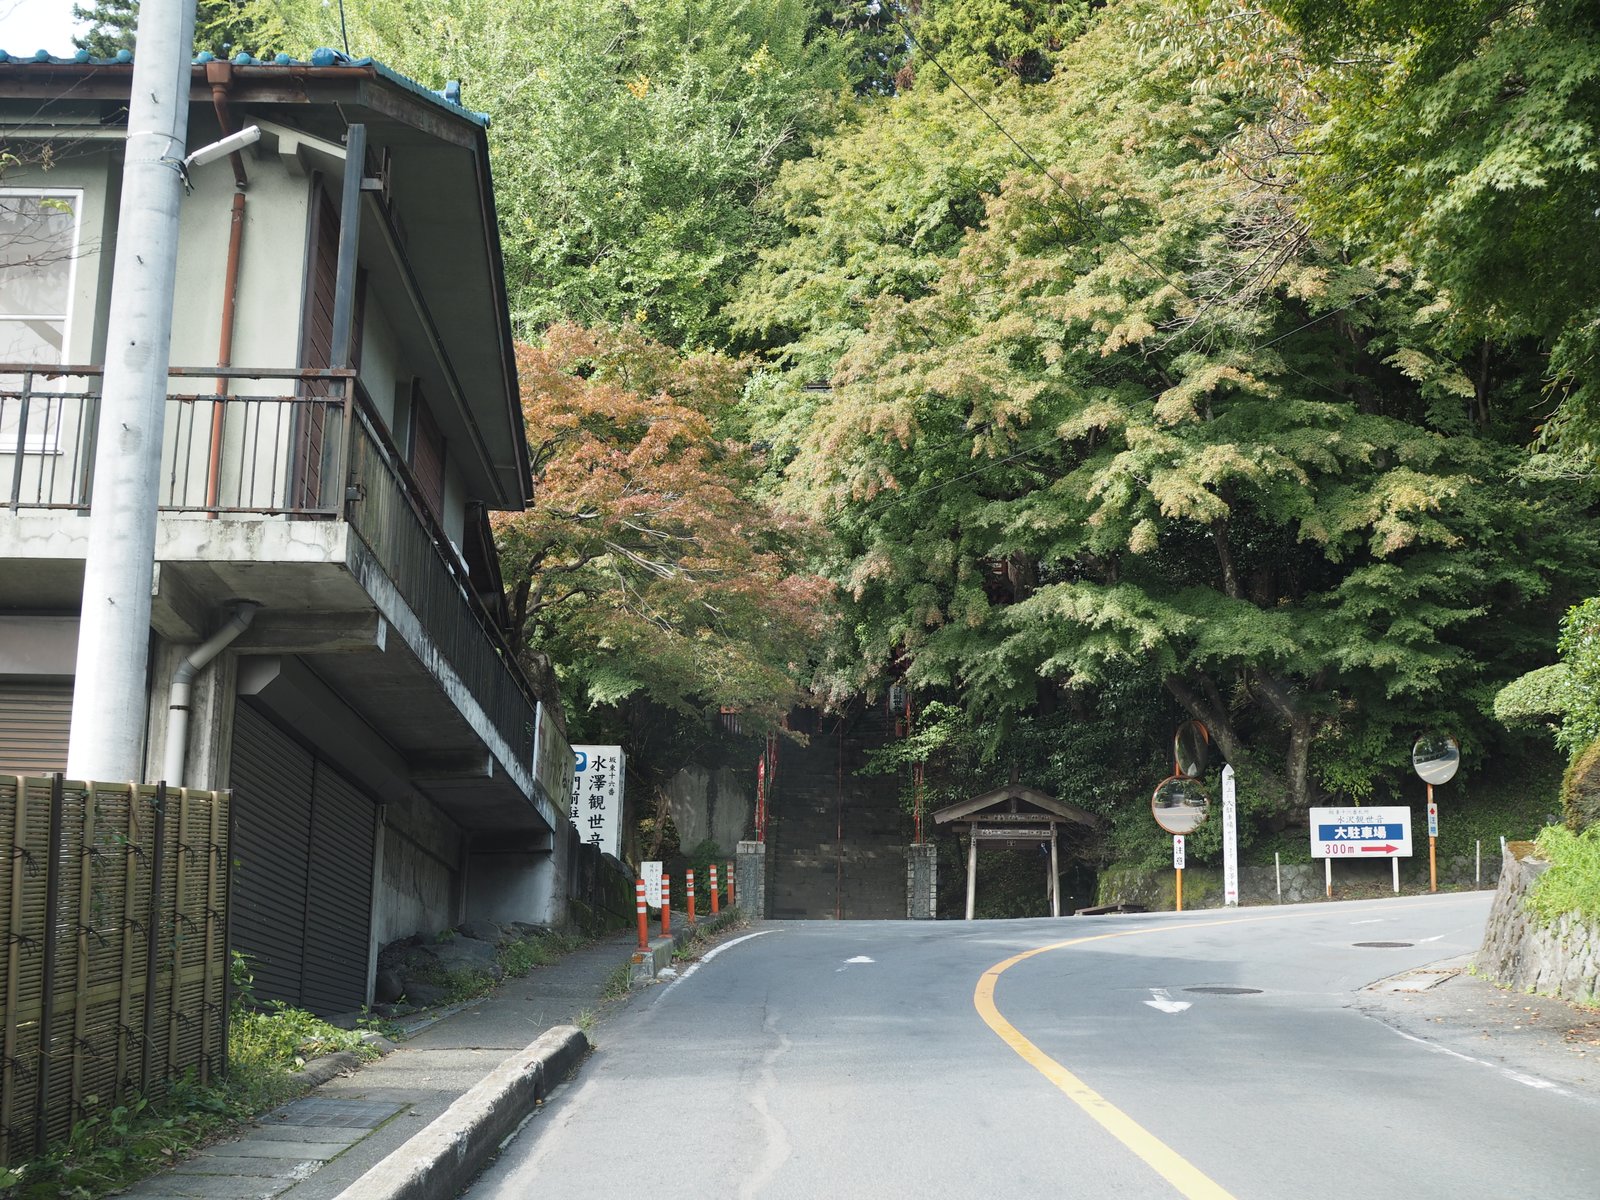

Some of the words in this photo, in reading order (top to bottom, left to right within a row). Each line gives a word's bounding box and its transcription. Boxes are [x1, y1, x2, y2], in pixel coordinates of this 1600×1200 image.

[608, 756, 617, 796] 坂東十六番
[587, 755, 608, 845] 水澤観世音
[1337, 815, 1384, 824] 水沢観世音
[1334, 826, 1387, 840] 大駐車場
[1176, 846, 1183, 866] 注意
[1325, 844, 1355, 855] 300m
